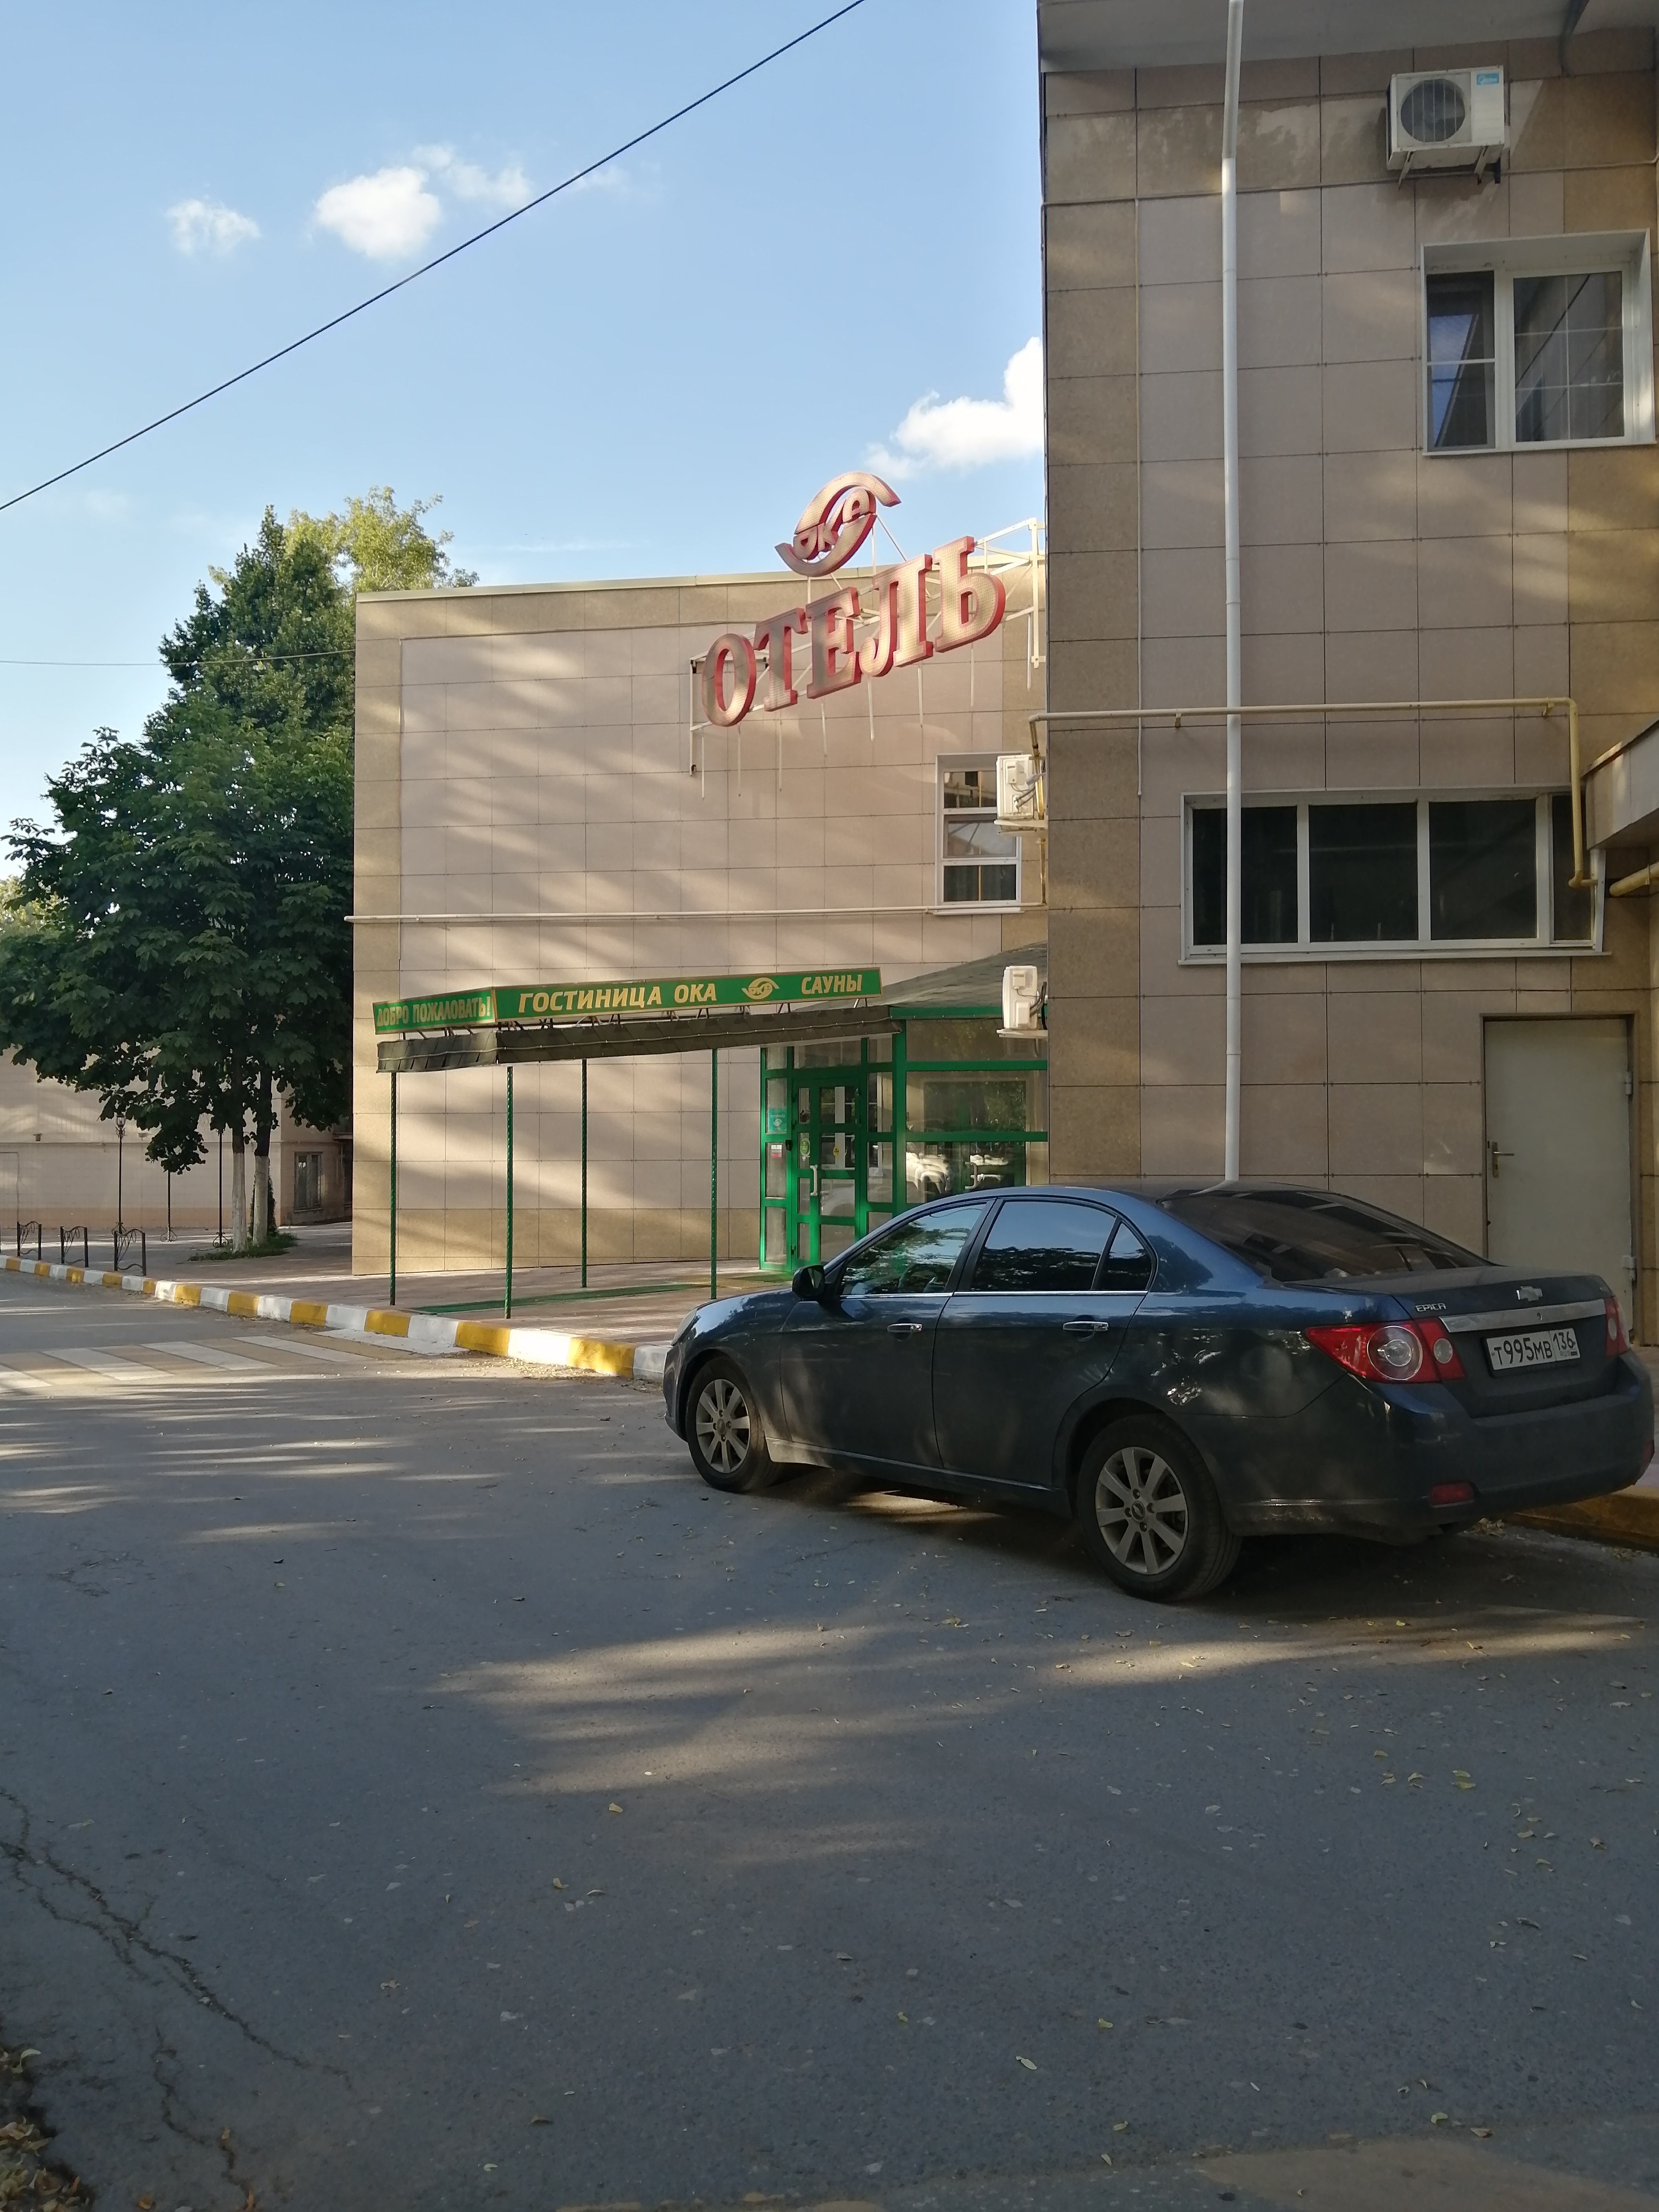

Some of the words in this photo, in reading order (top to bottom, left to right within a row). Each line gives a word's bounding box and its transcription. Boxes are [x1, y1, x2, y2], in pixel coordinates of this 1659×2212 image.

[701, 536, 1006, 727] ОТЕЛЬ
[518, 986, 662, 1013] ГОСТИНИЦА
[674, 983, 717, 1003] ОКА
[801, 974, 862, 995] САУНЫ
[377, 1005, 409, 1027] ДОБРО
[412, 996, 491, 1023] ПОЖАЛОВАТЬ!
[1415, 1303, 1447, 1312] EPICA
